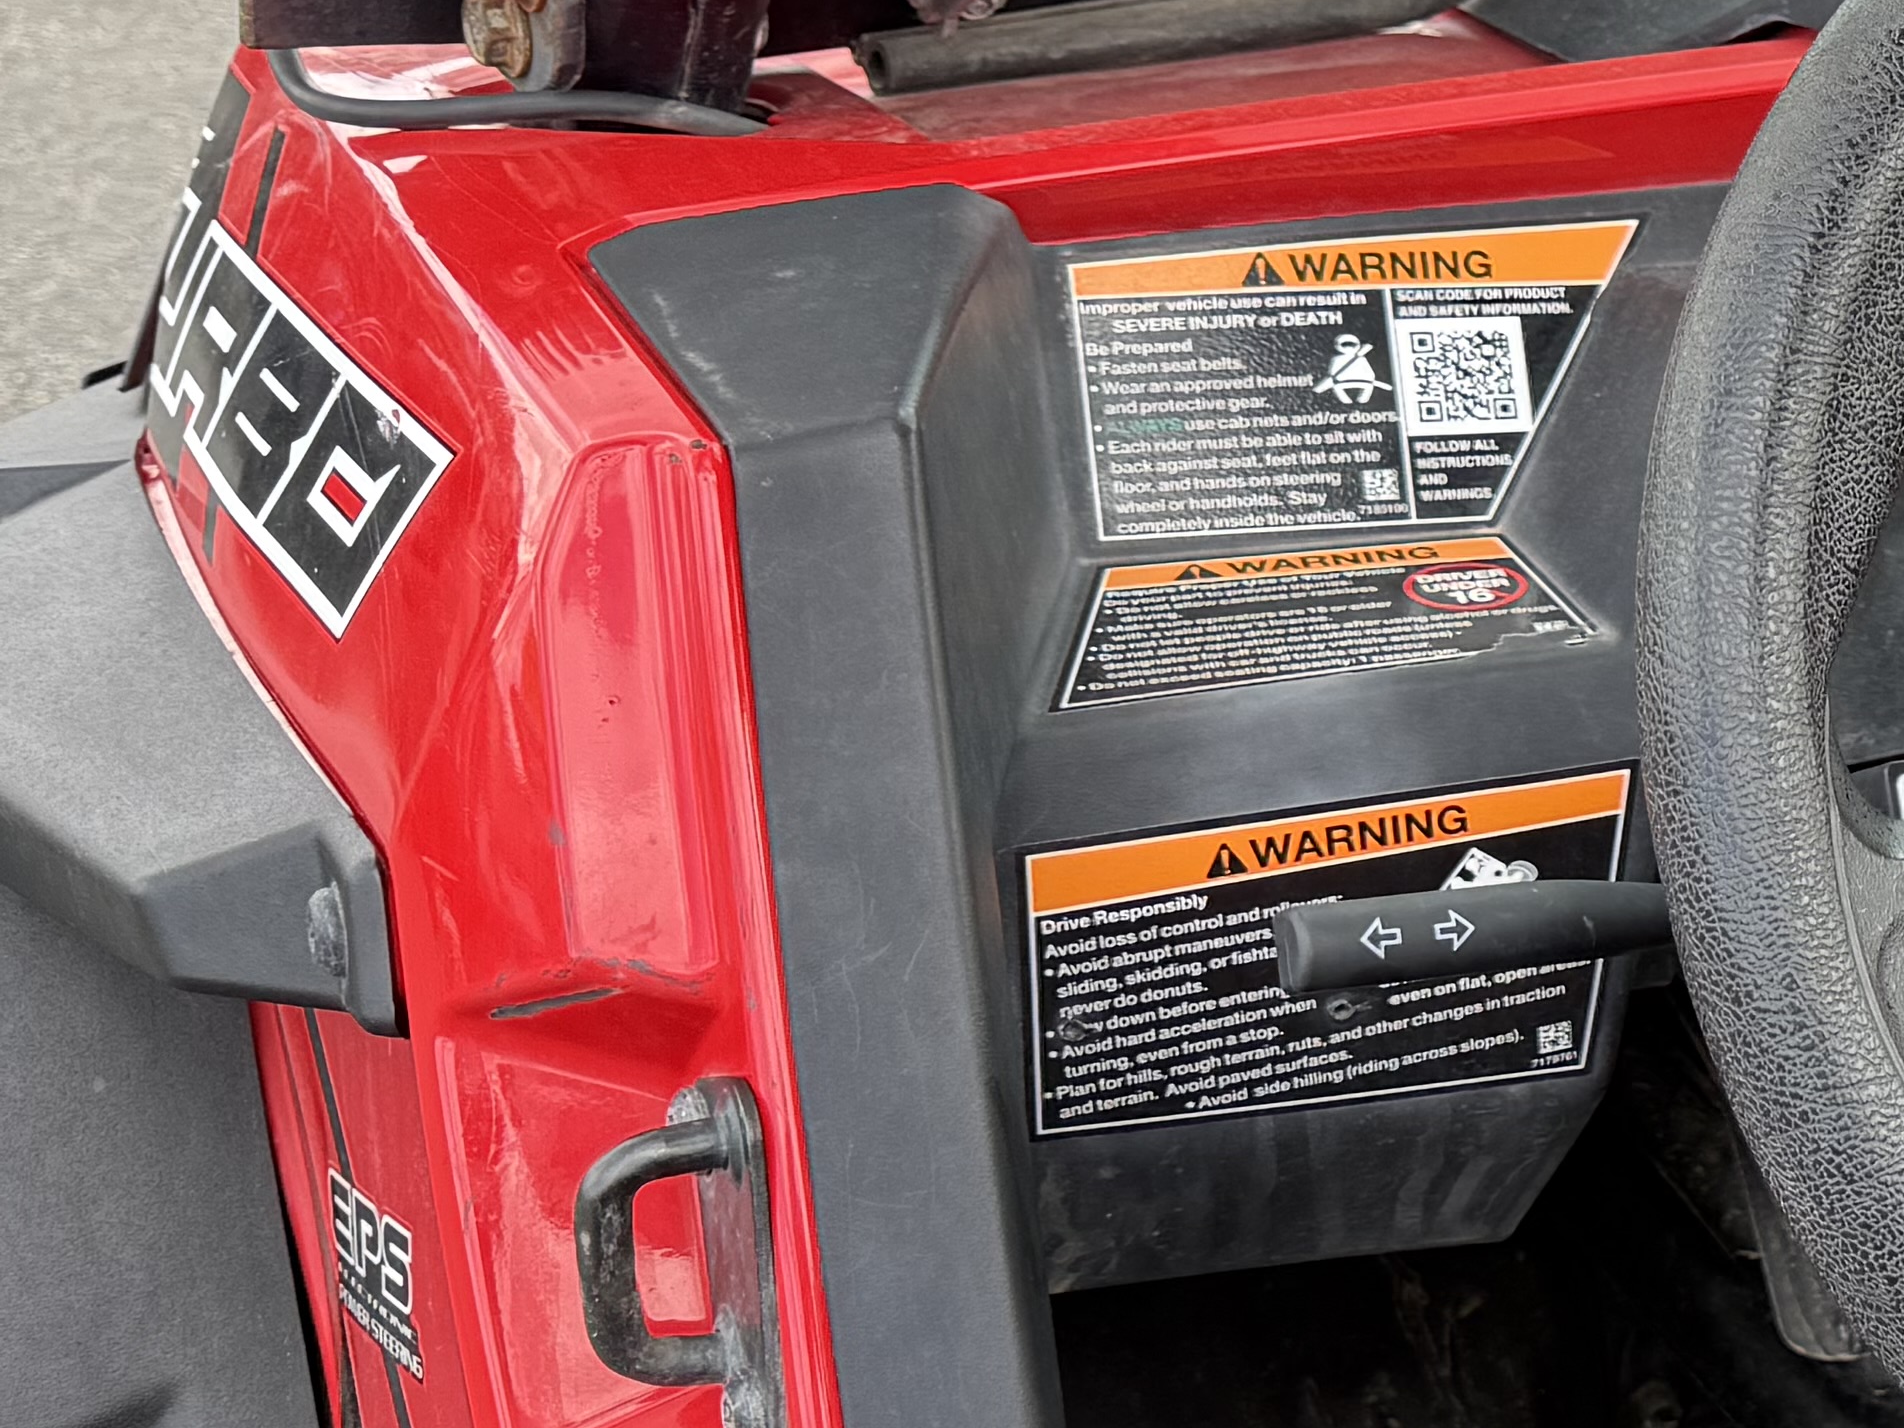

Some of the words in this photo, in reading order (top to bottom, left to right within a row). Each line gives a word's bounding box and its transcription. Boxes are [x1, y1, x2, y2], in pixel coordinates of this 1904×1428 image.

[1288, 250, 1493, 282] WARNING
[1080, 302, 1159, 317] Improper
[1167, 298, 1228, 312] vehicle
[1230, 299, 1261, 309] use
[1265, 298, 1297, 308] can
[1299, 294, 1348, 307] result
[1350, 294, 1366, 305] in
[1396, 289, 1433, 301] SCAN
[1436, 288, 1472, 300] CODE
[1475, 287, 1502, 299] FOR
[1505, 286, 1566, 299] PRODUCT
[1399, 304, 1426, 316] AND
[1429, 303, 1479, 316] SAFETY
[1481, 301, 1573, 315] INFORMATION.
[1113, 317, 1185, 333] SEVERE
[1189, 314, 1255, 330] INJURY
[1258, 316, 1278, 327] or
[1280, 311, 1342, 327] DEATH
[1085, 342, 1111, 356] Be
[1113, 338, 1192, 356] Prepared
[1101, 361, 1158, 375] Fasten
[1160, 358, 1197, 373] seat
[1200, 357, 1247, 371] belts.
[1102, 381, 1147, 394] Wear
[1149, 382, 1171, 392] an
[1172, 376, 1254, 394] approved
[1256, 374, 1313, 388] helmet
[1105, 400, 1137, 414] and
[1140, 398, 1221, 415] protective
[1224, 399, 1271, 413] gear.
[1184, 420, 1214, 431] use
[1216, 415, 1250, 430] cab
[1252, 414, 1290, 428] nets
[1291, 412, 1347, 427] and/or
[1349, 411, 1401, 424] doors.
[1108, 439, 1149, 454] Each
[1153, 438, 1193, 452] rider
[1196, 435, 1238, 451] must
[1241, 435, 1263, 449] be
[1266, 433, 1302, 448] able
[1305, 432, 1321, 446] to
[1324, 431, 1344, 445] sit
[1346, 430, 1382, 444] with
[1414, 440, 1470, 454] FOLLOW
[1473, 439, 1499, 451] ALL
[1110, 459, 1149, 474] back
[1153, 457, 1218, 475] against
[1266, 453, 1298, 467] feet
[1301, 452, 1326, 466] flat
[1329, 454, 1349, 465] on
[1351, 450, 1380, 464] the
[1415, 454, 1513, 469] INSTRUCTIONS
[1159, 477, 1191, 492] and
[1192, 475, 1247, 491] hands
[1249, 477, 1271, 488] on
[1273, 472, 1341, 487] steering
[1418, 473, 1448, 486] AND
[1117, 499, 1165, 514] wheel
[1168, 501, 1187, 511] or
[1190, 494, 1282, 510] handholds.
[1288, 492, 1327, 507] Stay
[1117, 517, 1210, 535] completely
[1213, 514, 1264, 529] inside
[1267, 512, 1297, 526] the
[1299, 509, 1361, 524] vehicle.
[1226, 546, 1441, 574] WARNING
[1414, 568, 1508, 584] DRIVER
[1421, 578, 1511, 594] UNDER
[1447, 588, 1497, 605] 16
[1249, 805, 1470, 869] WARNING
[1040, 916, 1090, 934] Drive
[1094, 896, 1208, 925] Responsibly
[1045, 936, 1097, 958] Avoid
[1100, 932, 1137, 948] loss
[1140, 925, 1158, 941] of
[1161, 913, 1223, 937] control
[1226, 906, 1260, 925] and
[1058, 956, 1109, 978] Avoid
[1112, 945, 1172, 968] abrupt
[1210, 953, 1228, 968] or
[1230, 942, 1278, 964] fishta
[1388, 986, 1432, 1005] even
[1434, 981, 1456, 995] on
[1495, 966, 1536, 984] open
[1060, 998, 1110, 1018] never
[1113, 993, 1138, 1008] do
[1140, 982, 1208, 1003] donuts.
[1107, 1010, 1155, 1030] down
[1158, 999, 1216, 1020] before
[1061, 1036, 1112, 1059] Avoid
[1116, 1027, 1156, 1048] hard
[1158, 1009, 1267, 1040] acceleration
[1270, 1000, 1316, 1018] when
[1056, 1082, 1096, 1100] Plan
[1100, 1076, 1124, 1091] for
[1170, 1054, 1221, 1077] rough
[1328, 1025, 1362, 1044] and
[1366, 1018, 1410, 1036] other
[1412, 1003, 1484, 1027] changes
[1486, 998, 1500, 1012] in
[1502, 986, 1566, 1008] traction
[1136, 1046, 1180, 1064] even
[1182, 1037, 1224, 1055] from
[1226, 1035, 1238, 1046] a
[1241, 1027, 1284, 1043] stop.
[1200, 1086, 1248, 1109] Avoid
[1252, 1079, 1289, 1097] side
[1293, 1068, 1343, 1089] hilling
[1347, 1057, 1399, 1079] (riding
[1402, 1044, 1458, 1065] across
[1460, 1029, 1524, 1053] slopes).
[1060, 1099, 1093, 1119] and
[1096, 1089, 1159, 1111] terrain.
[1165, 1074, 1216, 1097] Avoid
[1219, 1062, 1272, 1088] paved
[1274, 1051, 1352, 1074] surfaces.
[328, 1167, 412, 1315] EPS
[339, 1283, 371, 1332] POWER
[371, 1318, 424, 1380] STEERING
